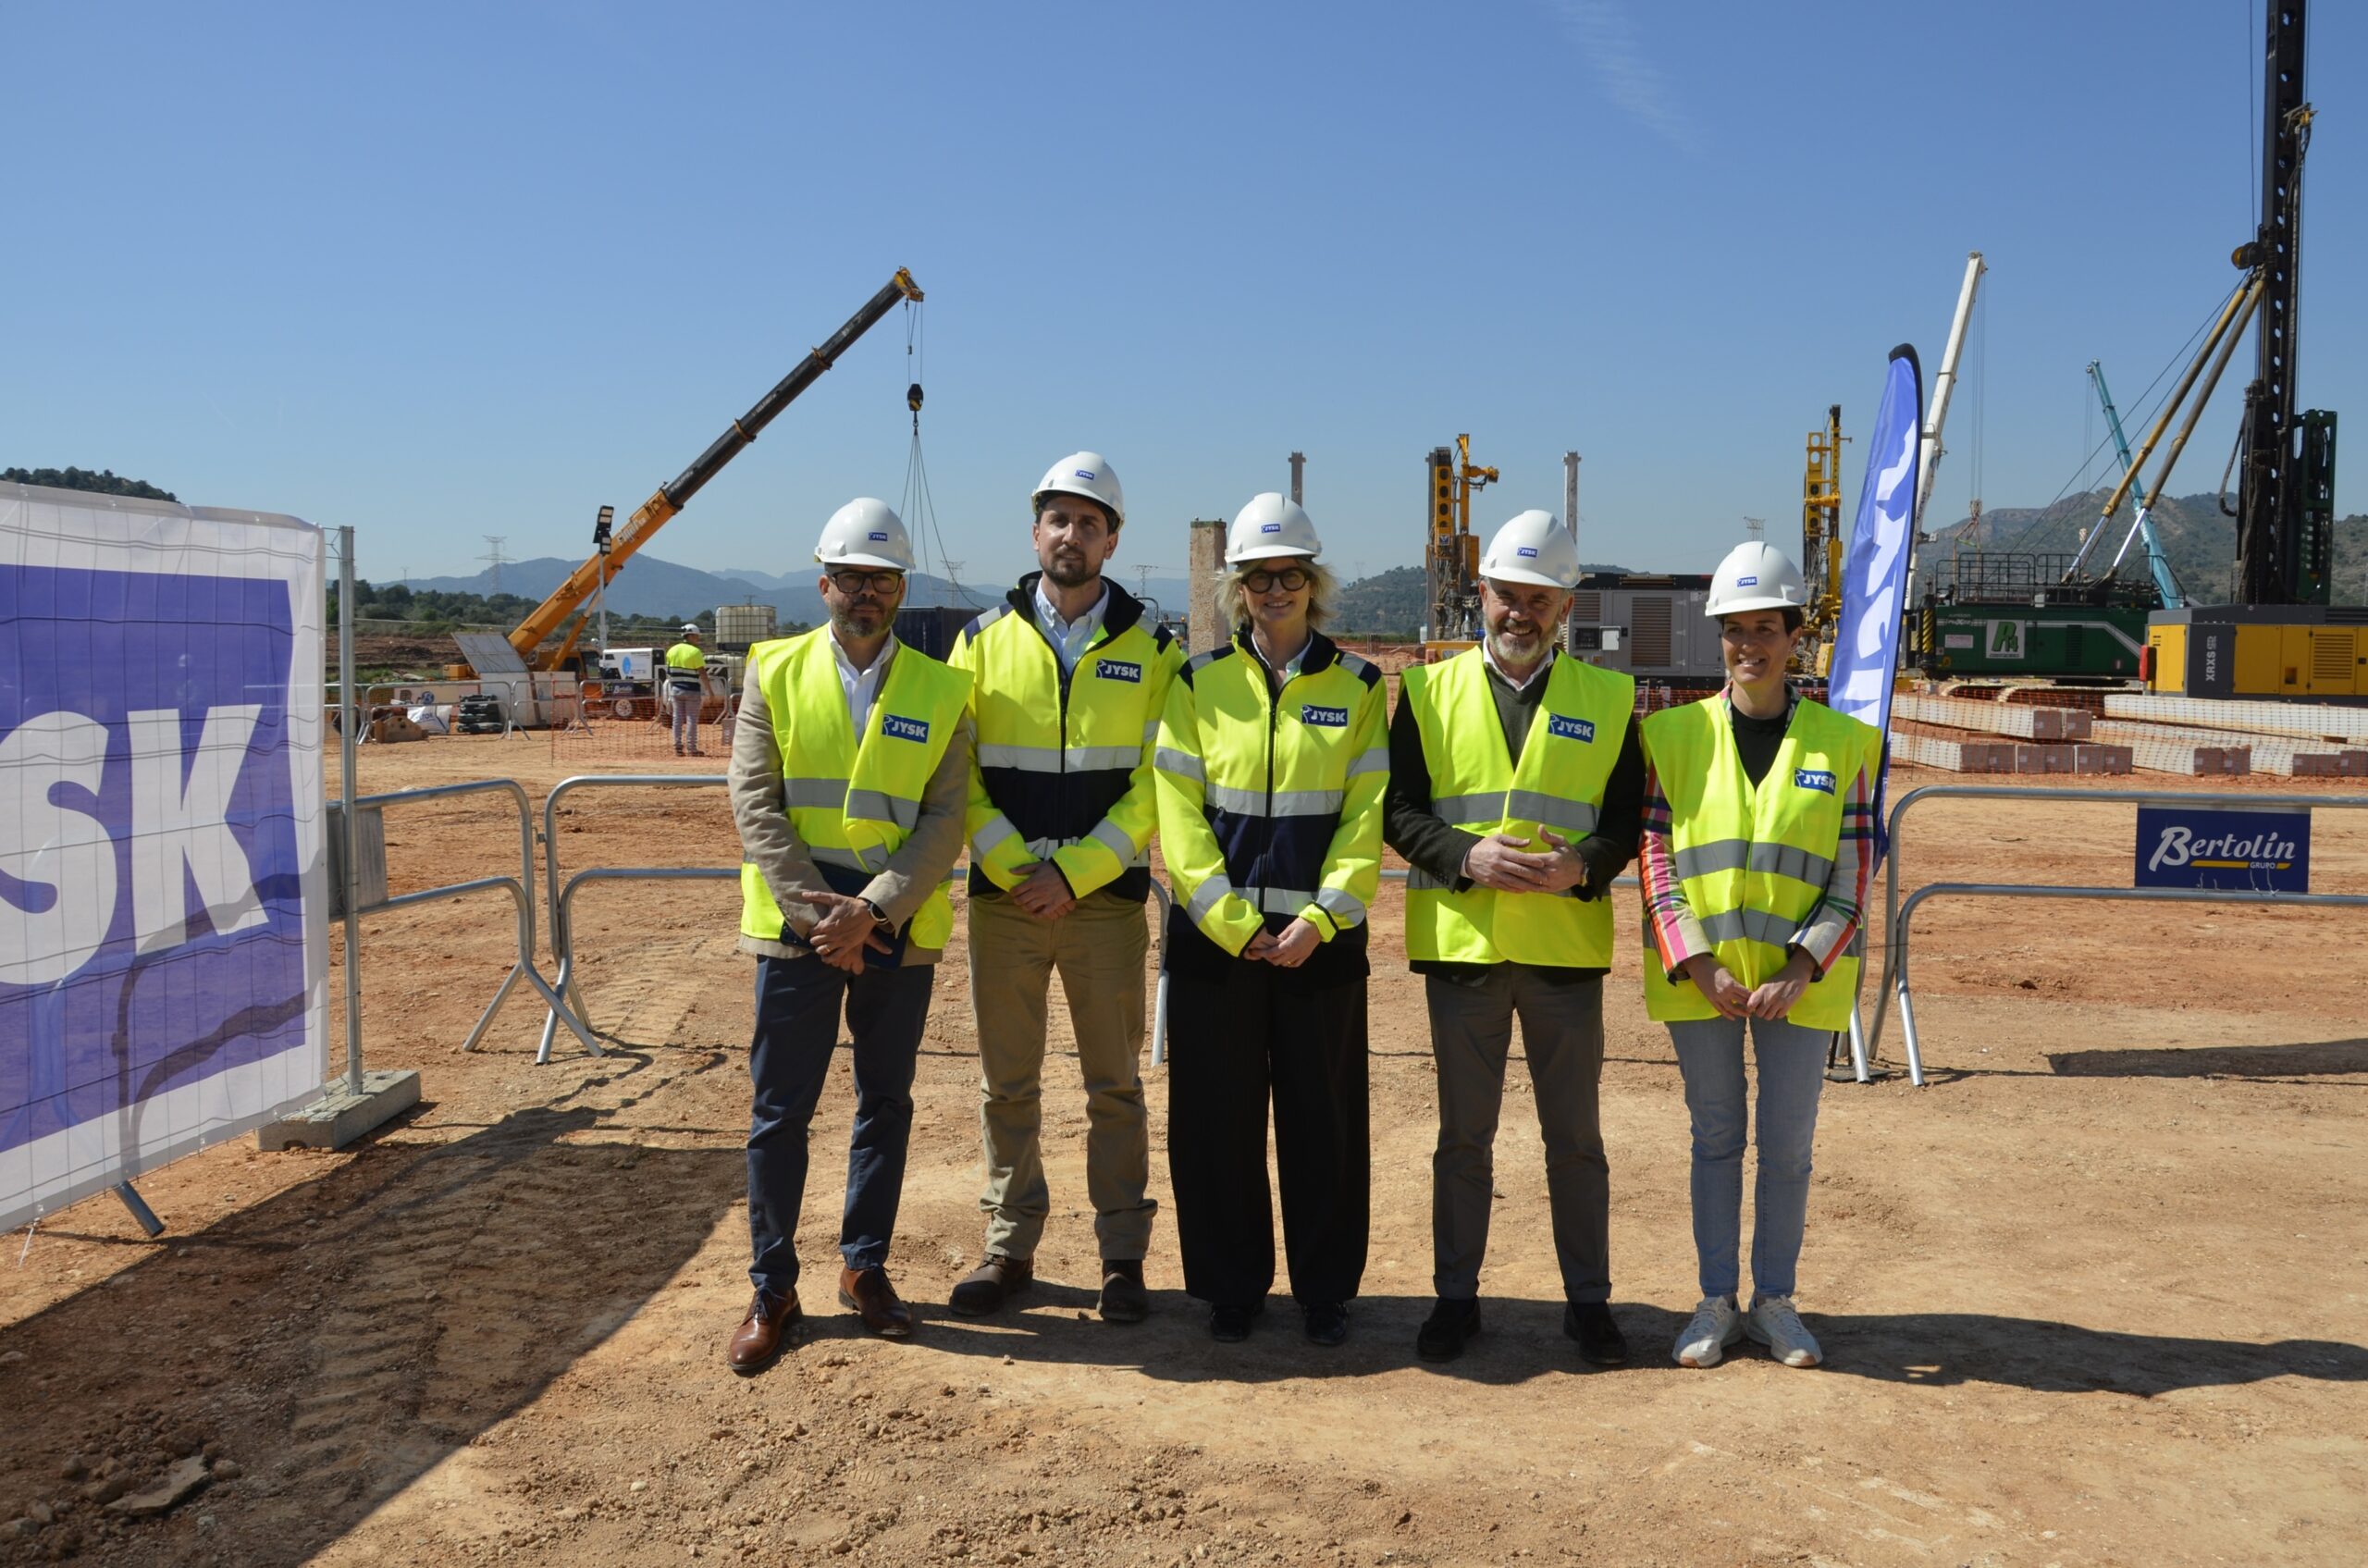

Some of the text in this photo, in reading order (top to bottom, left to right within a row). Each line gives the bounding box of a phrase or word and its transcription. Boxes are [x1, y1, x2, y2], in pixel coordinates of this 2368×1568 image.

[1104, 664, 1139, 678] JYSK
[2205, 650, 2216, 682] XRXS
[1311, 710, 1345, 722] JYSK
[891, 721, 926, 737] JYSK
[1557, 721, 1592, 737] JYSK
[1804, 774, 1835, 790] JYSK
[2148, 826, 2296, 871] Bertolín
[2250, 861, 2276, 870] GRUPO
